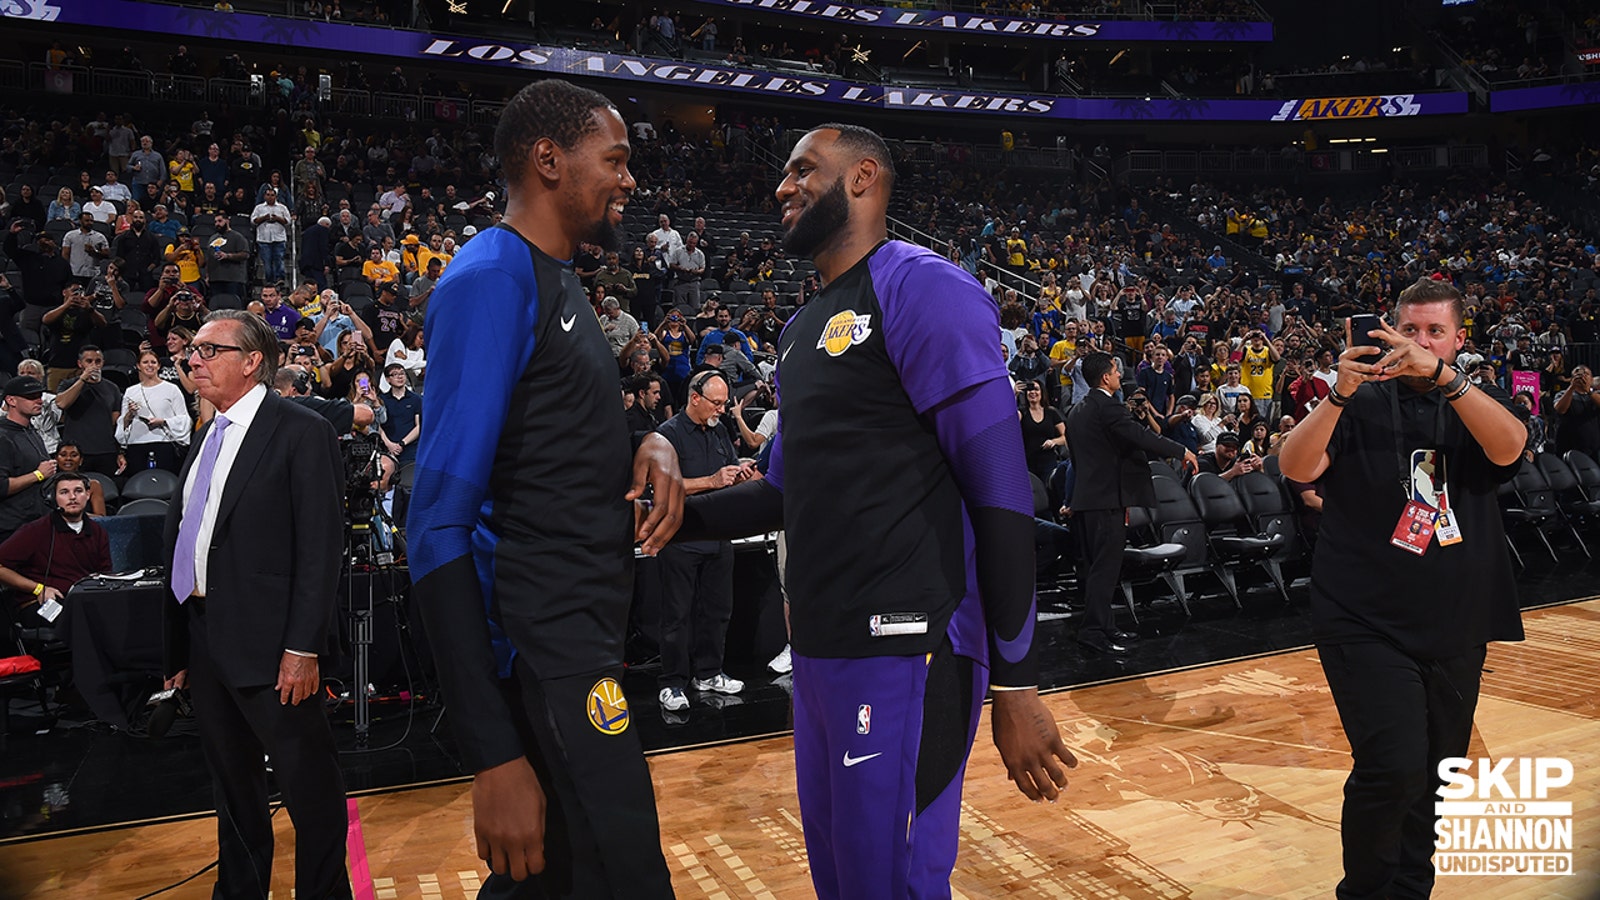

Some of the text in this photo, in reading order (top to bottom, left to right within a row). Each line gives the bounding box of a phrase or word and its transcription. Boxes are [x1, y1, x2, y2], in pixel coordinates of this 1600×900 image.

[894, 11, 1101, 37] LAKERS
[419, 38, 1055, 113] LOS ANGELES LAKERS
[441, 104, 450, 117] 5
[1277, 95, 1413, 122] LAKERS
[380, 317, 397, 332] 24
[820, 322, 867, 346] LAKERS
[1250, 364, 1265, 376] 23
